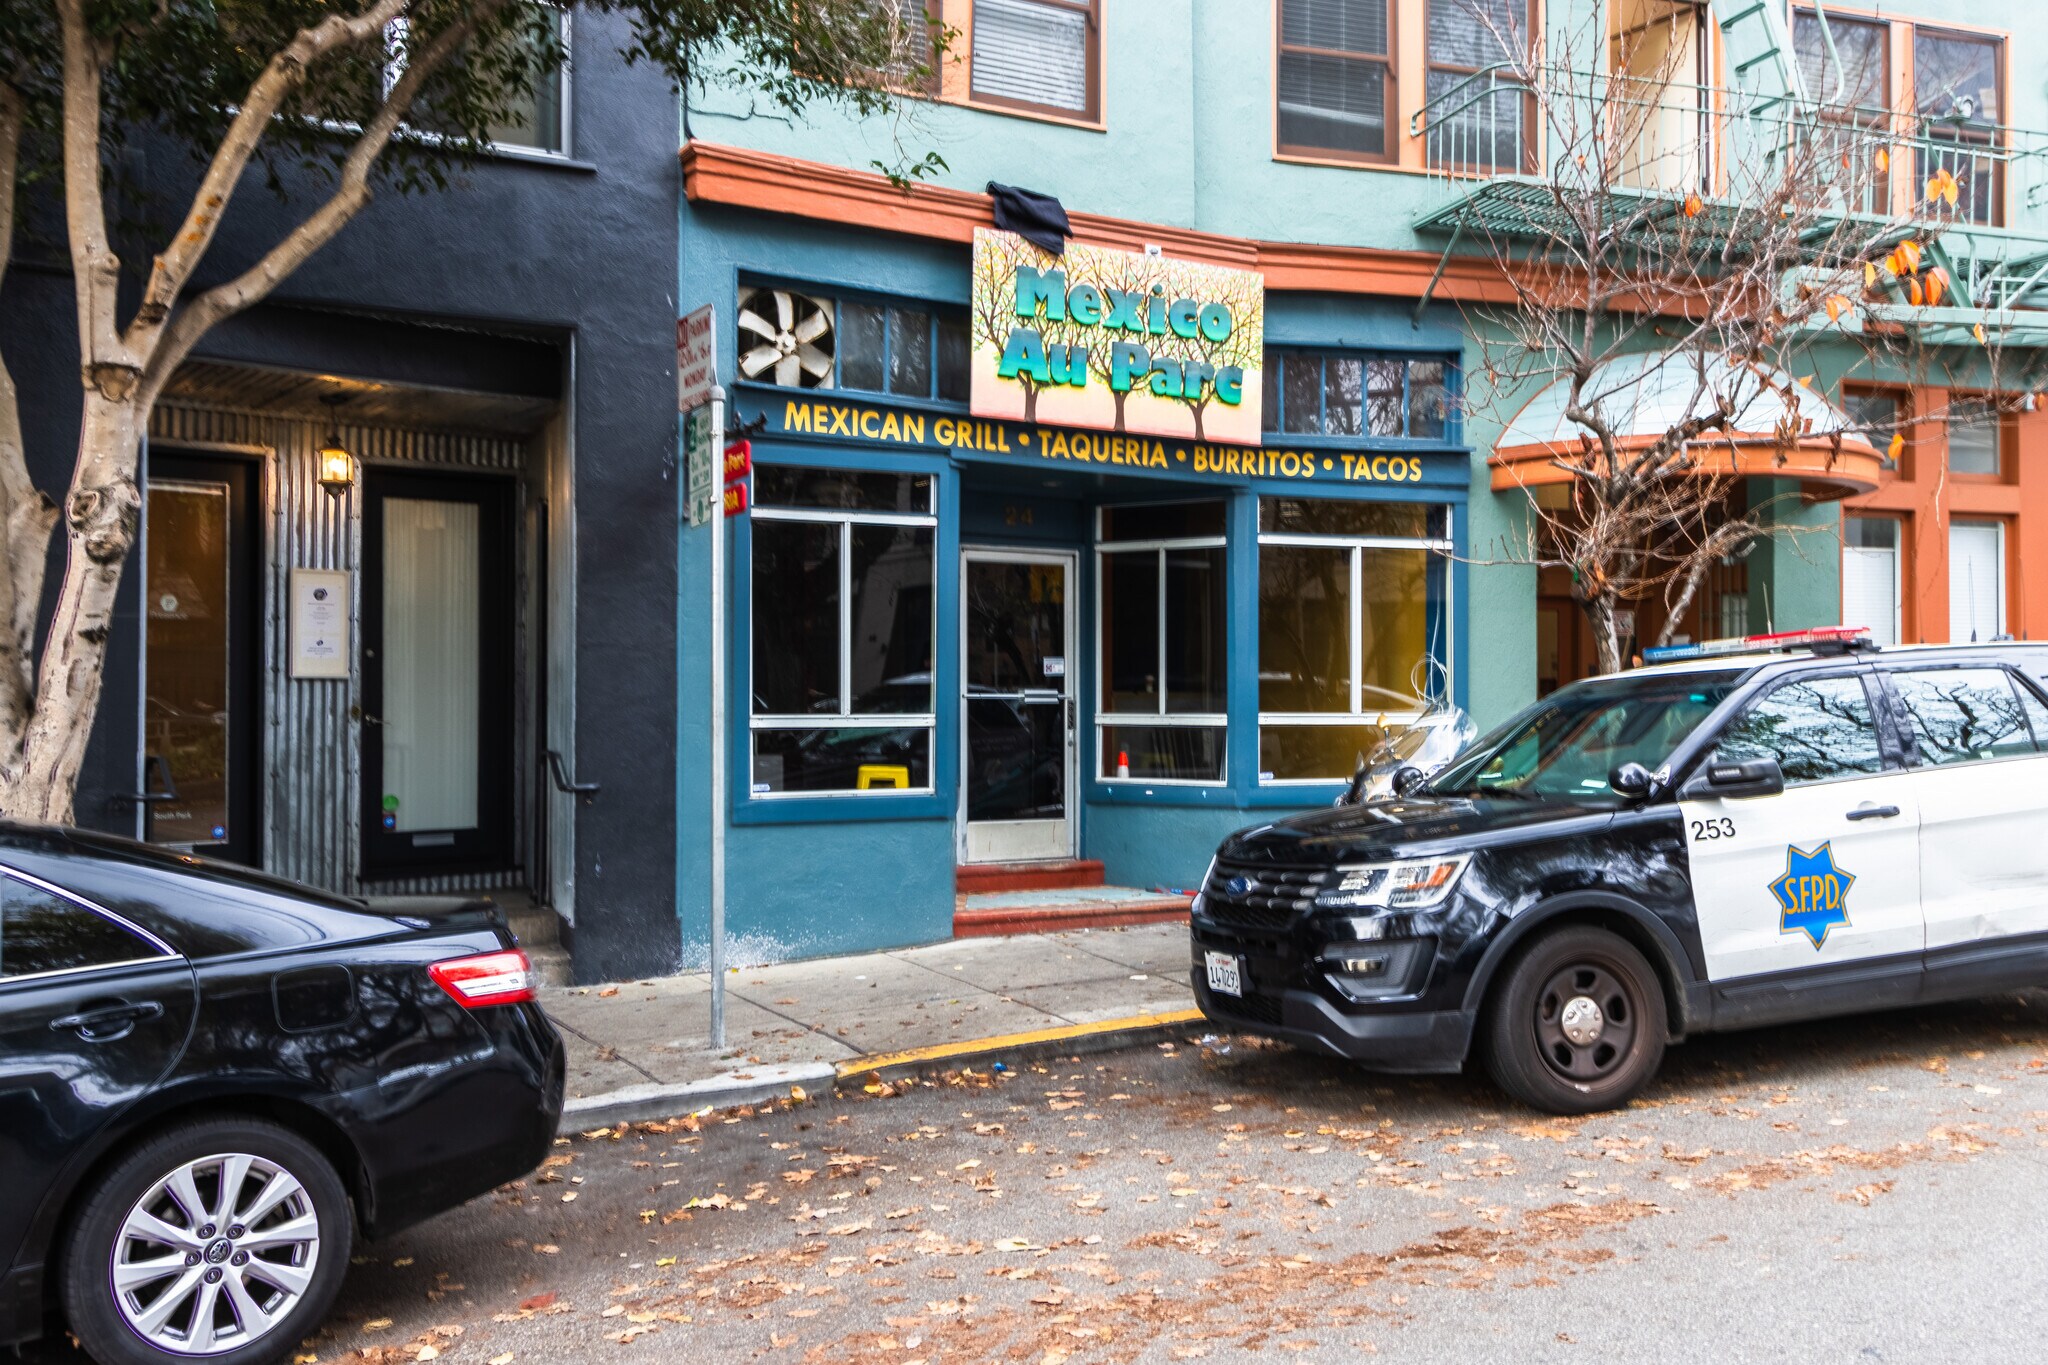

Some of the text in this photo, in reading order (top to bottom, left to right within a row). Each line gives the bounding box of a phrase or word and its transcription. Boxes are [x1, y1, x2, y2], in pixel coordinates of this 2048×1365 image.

[1015, 264, 1232, 342] Mexico
[997, 327, 1244, 405] Au Parc
[784, 401, 1423, 482] MEXICAN GRILL TAQUERIA BURRITOS TACOS
[1005, 506, 1034, 527] 24
[1691, 817, 1736, 842] 253
[1785, 873, 1841, 915] S.F.P.D.
